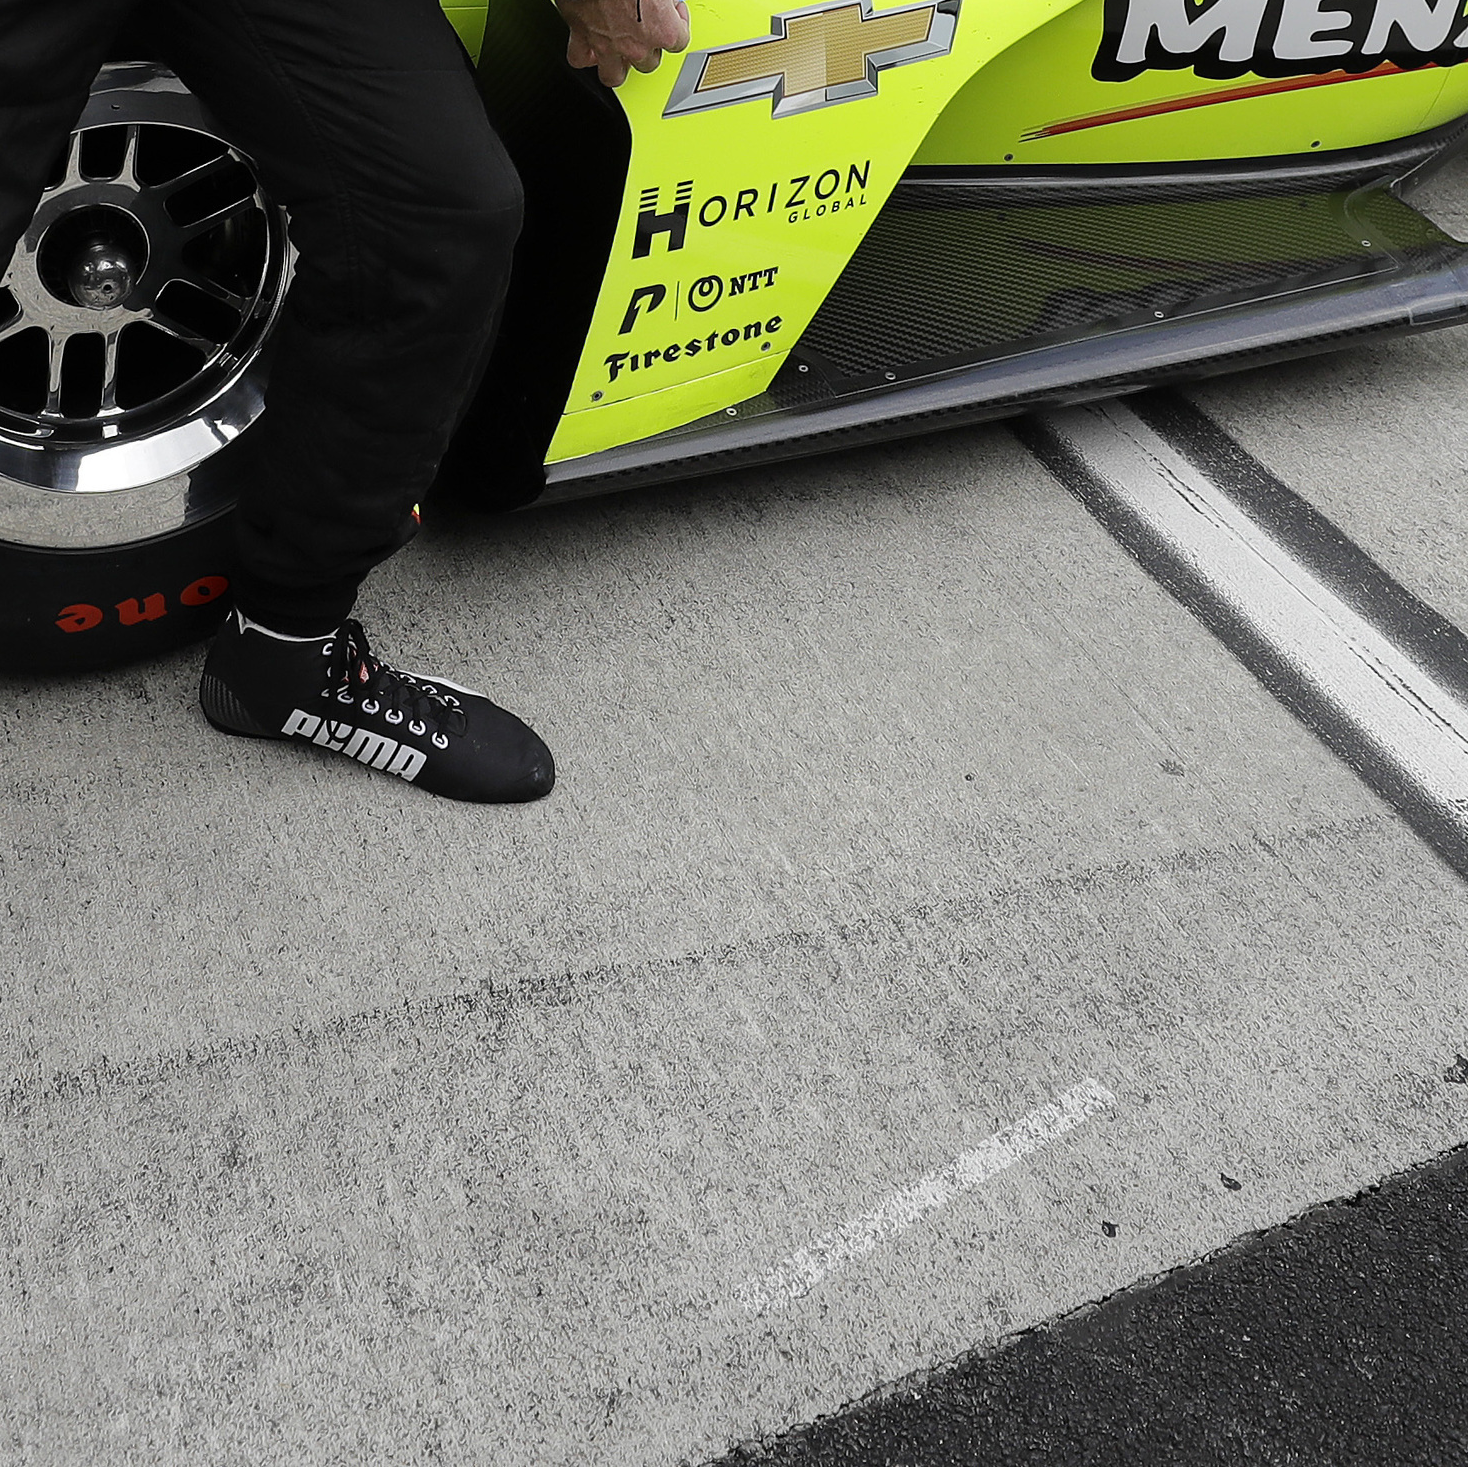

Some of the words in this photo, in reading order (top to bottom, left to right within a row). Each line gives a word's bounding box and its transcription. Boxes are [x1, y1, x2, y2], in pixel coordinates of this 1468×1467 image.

[631, 159, 872, 260] HORIZON
[787, 193, 869, 224] GLOBAL
[728, 265, 780, 298] NTT
[603, 314, 784, 383] Firestone
[281, 706, 428, 783] PUMA
